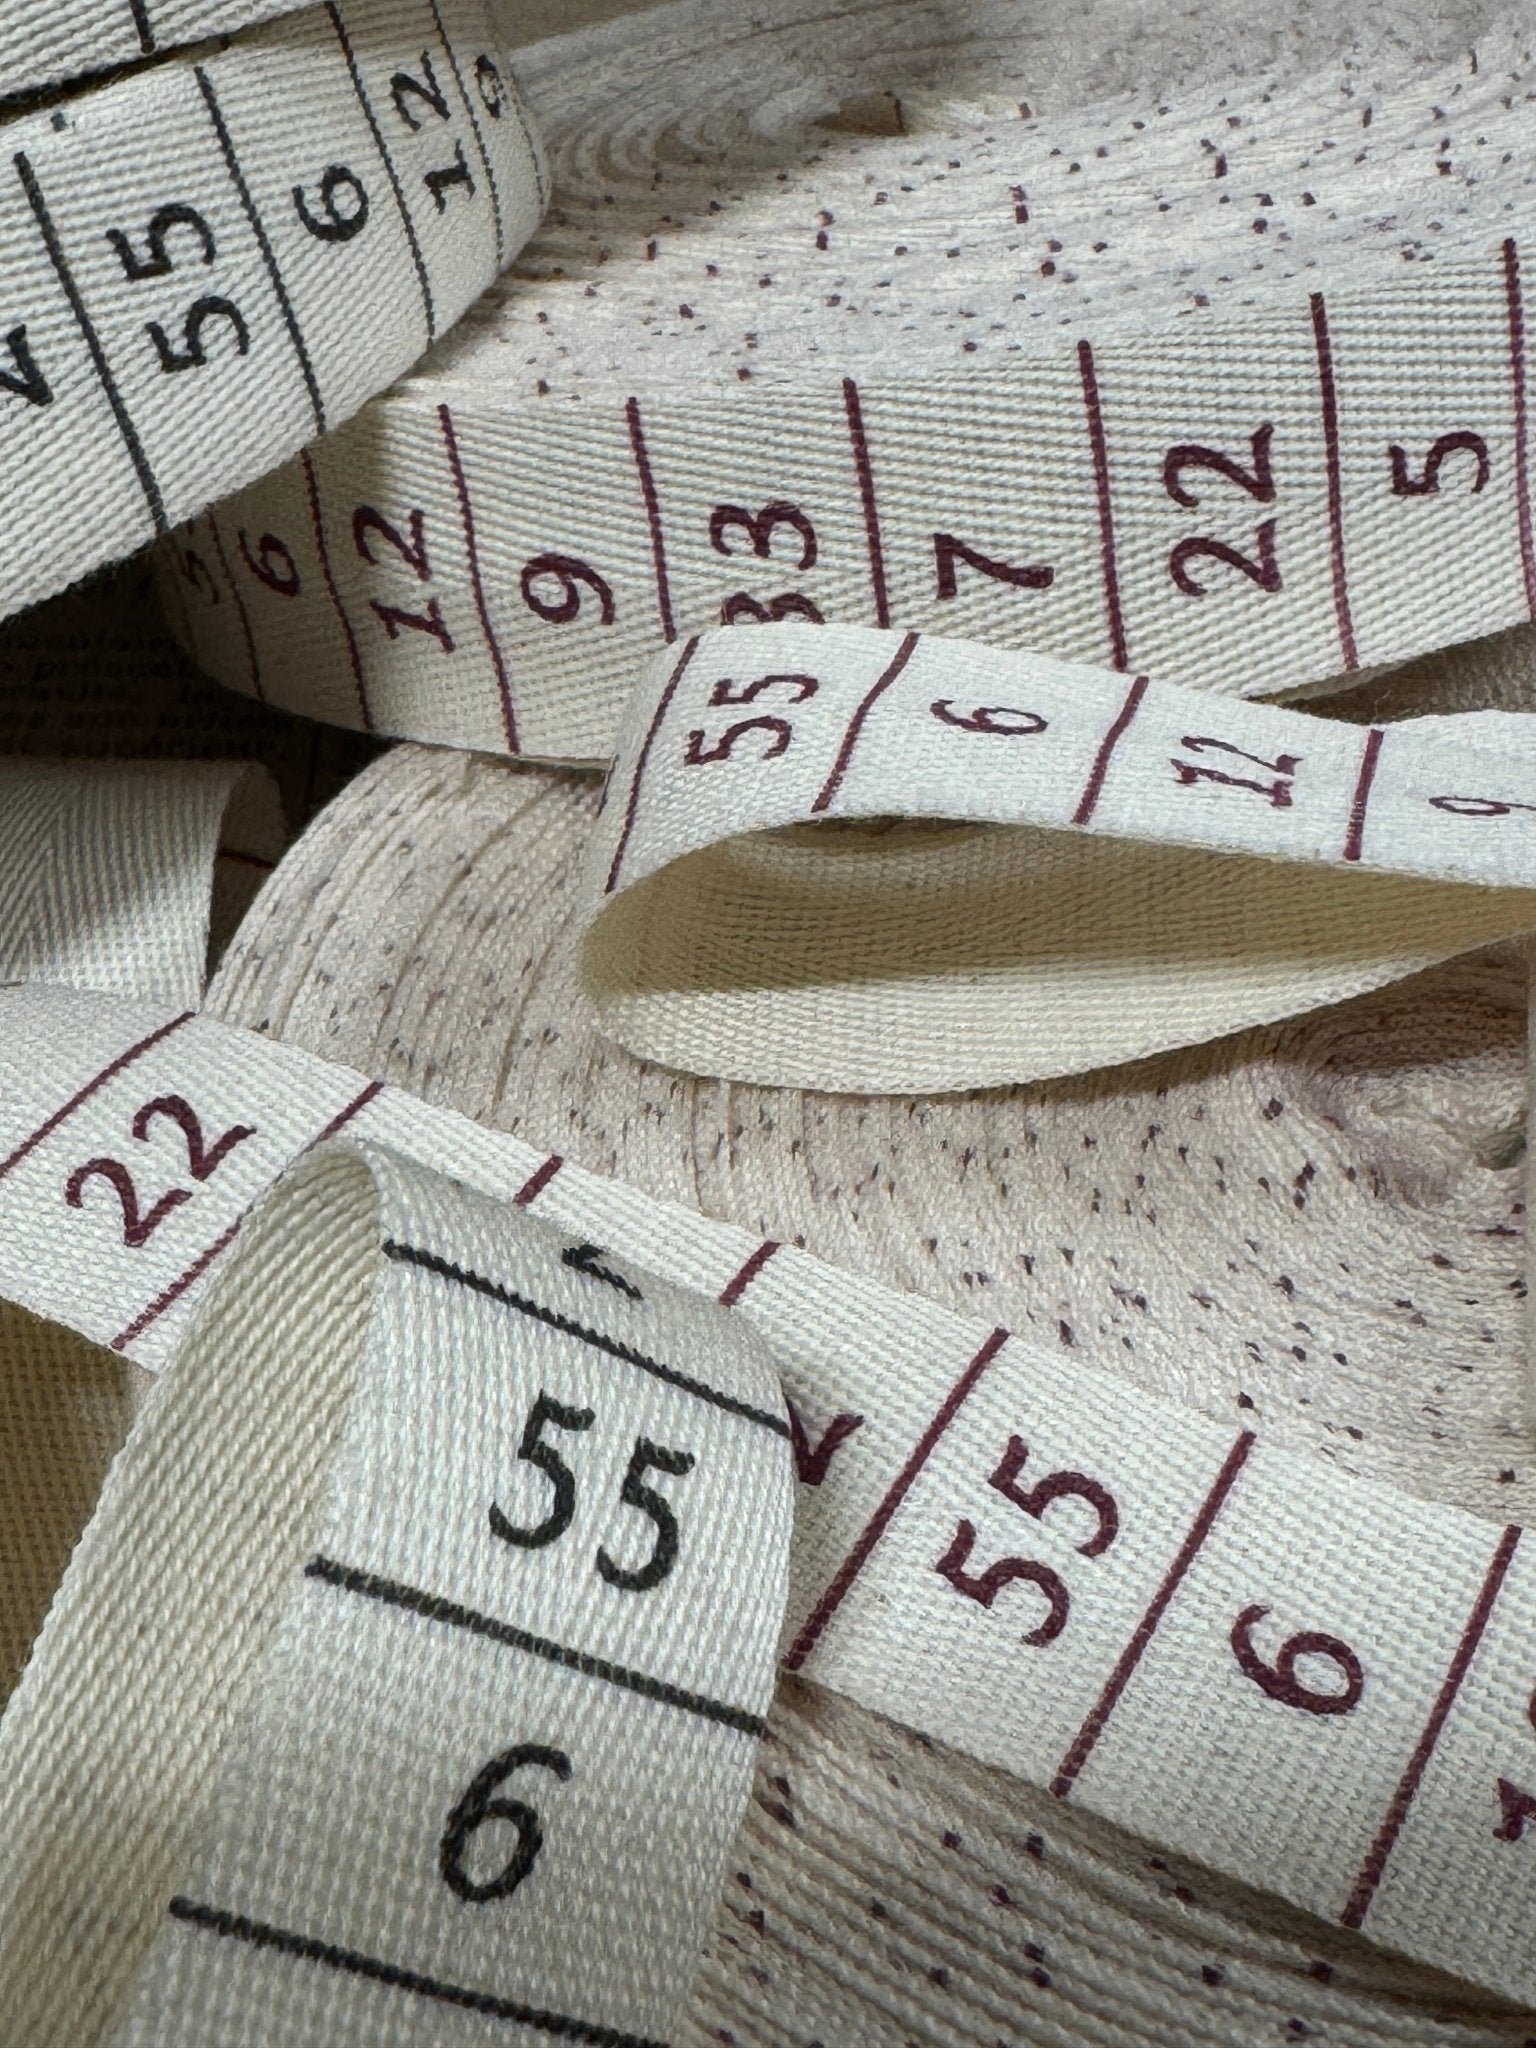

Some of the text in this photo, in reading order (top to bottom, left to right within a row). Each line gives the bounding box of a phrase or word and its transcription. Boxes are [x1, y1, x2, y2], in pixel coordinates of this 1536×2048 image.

[389, 50, 475, 214] 12
[292, 165, 369, 243] 6
[106, 203, 249, 374] 55
[1163, 421, 1282, 595] 22
[1388, 430, 1490, 497] 5
[238, 530, 300, 598] 6
[353, 504, 455, 653] 12
[520, 552, 617, 625] 9
[932, 532, 1054, 600] 7
[684, 675, 819, 766] 55
[930, 700, 1048, 736] 6
[65, 1094, 257, 1248] 22
[488, 1390, 697, 1593] 55
[935, 1434, 1119, 1648] 55
[1229, 1604, 1364, 1716] 6
[439, 1743, 572, 1905] 6
